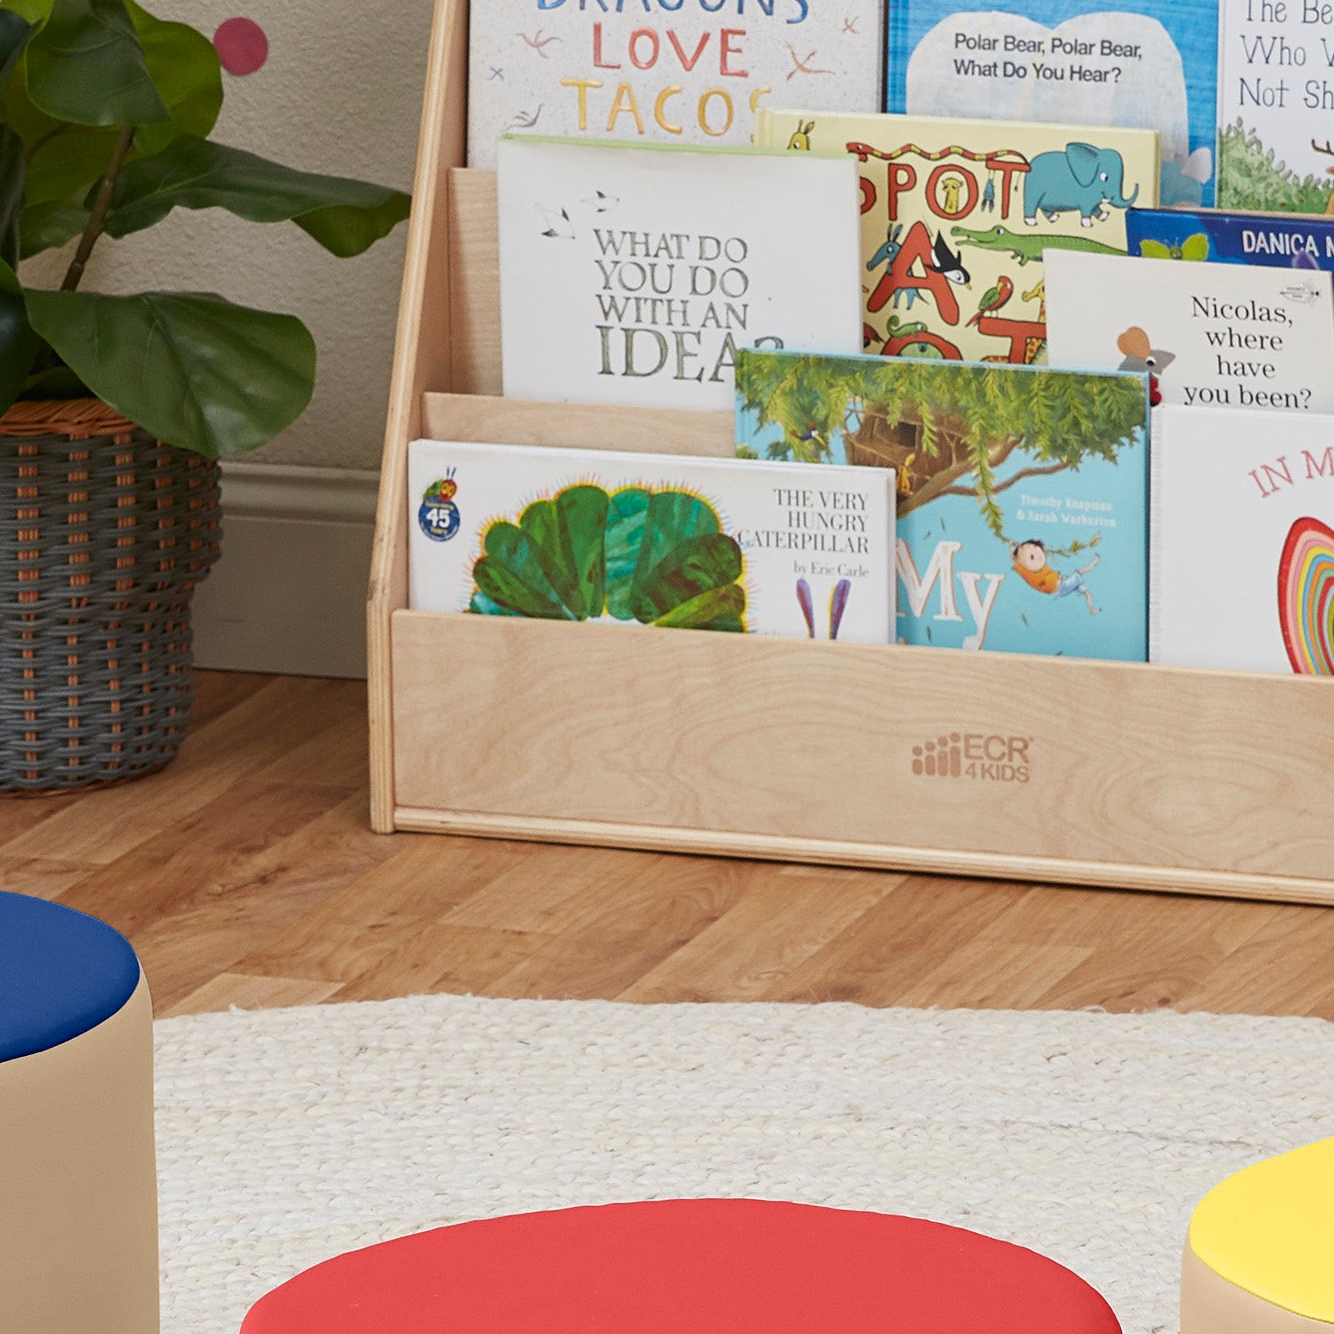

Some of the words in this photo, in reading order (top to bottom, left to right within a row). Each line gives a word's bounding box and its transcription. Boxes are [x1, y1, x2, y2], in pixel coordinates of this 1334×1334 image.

[592, 22, 750, 78] LOVE
[954, 33, 999, 51] Polar
[1003, 35, 1046, 56] Bear,
[1051, 38, 1096, 57] Polar
[1100, 40, 1142, 61] Bear,
[1240, 35, 1307, 67] Who
[953, 59, 999, 78] What
[1002, 61, 1028, 79] Do
[1032, 62, 1065, 80] You
[1069, 65, 1122, 83] Hear?
[1239, 77, 1291, 109] Not
[593, 229, 690, 261] WHAT
[698, 235, 749, 264] DO
[1242, 230, 1320, 258] DANICA
[594, 260, 675, 295] YOU
[689, 265, 750, 299] DO
[867, 220, 960, 327] A
[595, 294, 689, 327] WITH
[700, 302, 749, 331] AN
[1189, 295, 1294, 328] Nicolas,
[1204, 328, 1284, 352] where
[1216, 354, 1276, 380] have
[1183, 384, 1231, 407] you
[1238, 384, 1312, 410] been?
[1247, 456, 1295, 498] IN
[772, 487, 814, 508] THE
[818, 489, 869, 512] VERY
[425, 507, 451, 529] 45
[787, 511, 869, 533] HUNGRY
[737, 528, 870, 555] CATERPILLAR
[794, 560, 807, 575] by
[811, 561, 835, 576] Eric
[837, 562, 869, 578] Carle
[896, 539, 1006, 651] My
[963, 733, 1030, 765] ECR
